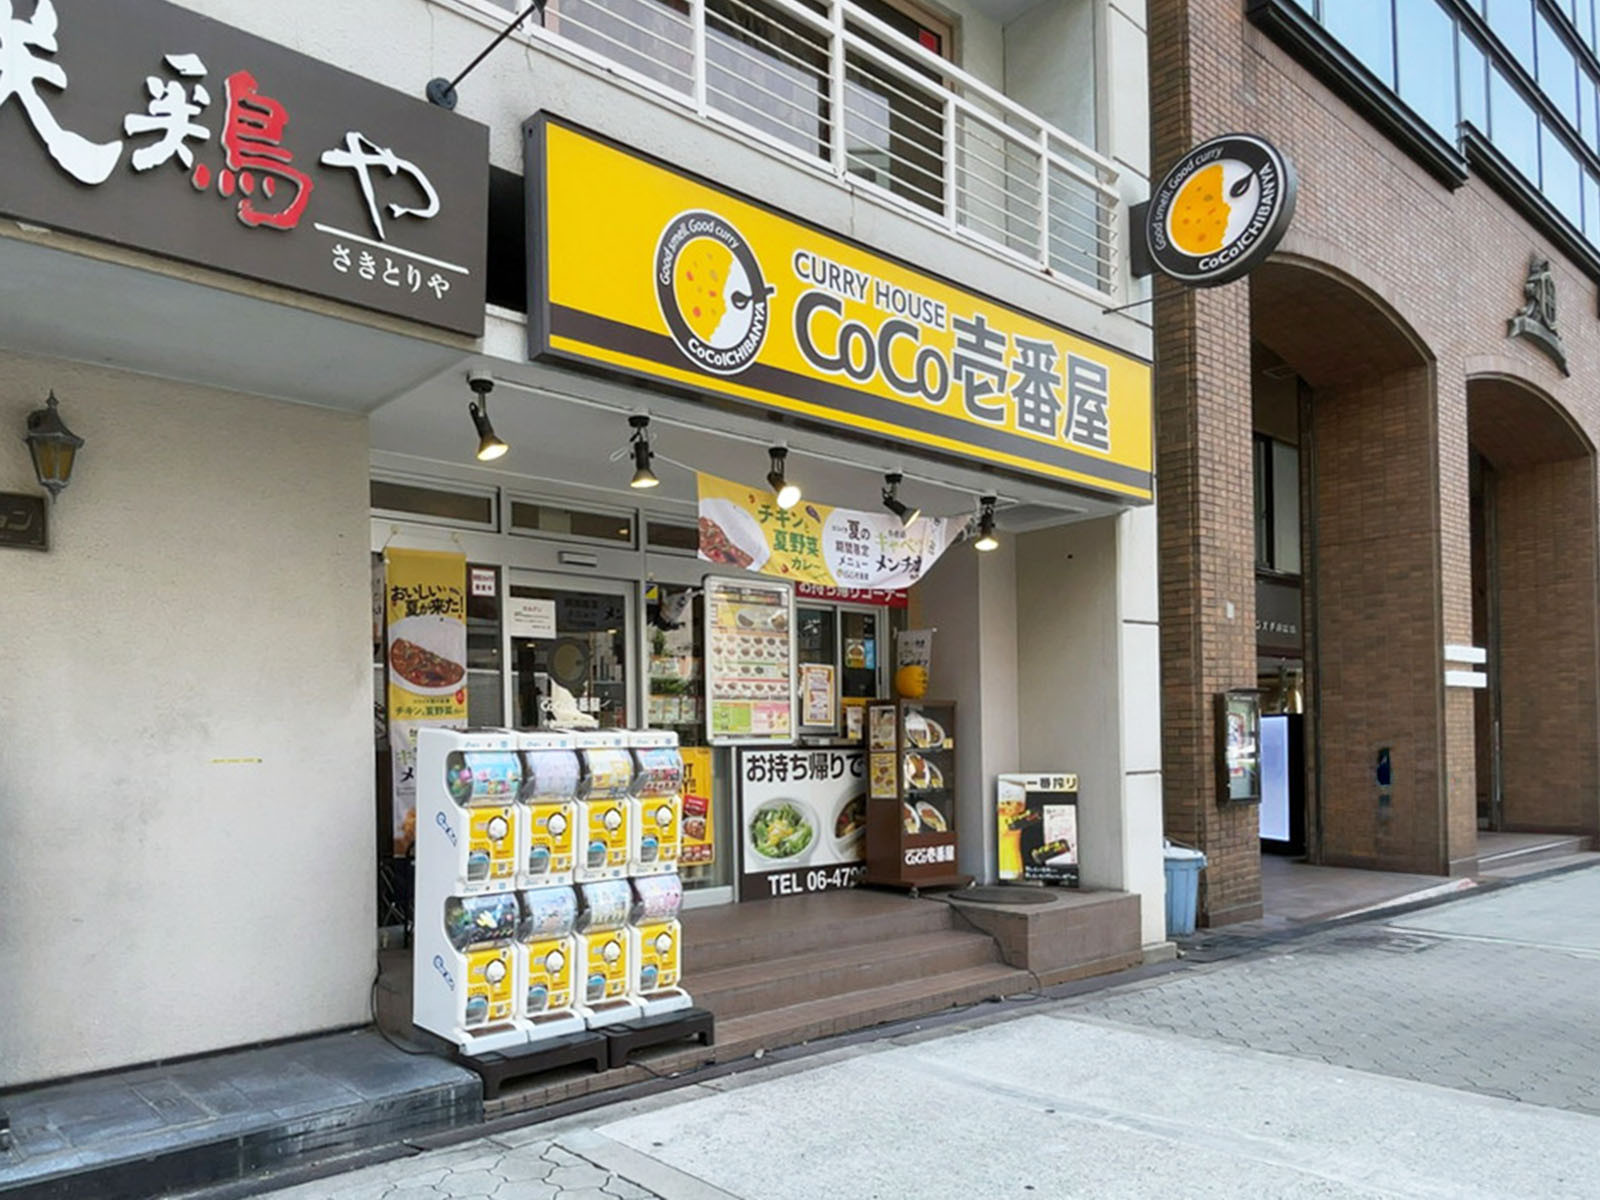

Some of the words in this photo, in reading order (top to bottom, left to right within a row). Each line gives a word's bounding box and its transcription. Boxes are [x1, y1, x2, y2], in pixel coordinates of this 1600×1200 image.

[1152, 221, 1167, 250] Good
[1170, 161, 1195, 189] Good
[1194, 146, 1224, 165] curry
[332, 243, 450, 299] さきとりや
[659, 246, 675, 285] Good
[688, 218, 714, 234] Good
[715, 228, 740, 249] curry
[794, 251, 869, 300] CURRY
[875, 277, 945, 329] HOUSE
[795, 290, 1110, 451] CoCo壱番屋
[773, 531, 819, 558] 夏野菜
[791, 556, 822, 571] カレー
[837, 556, 869, 568] メニュー
[747, 753, 864, 783] お持ち帰りで
[767, 873, 803, 896] TEL
